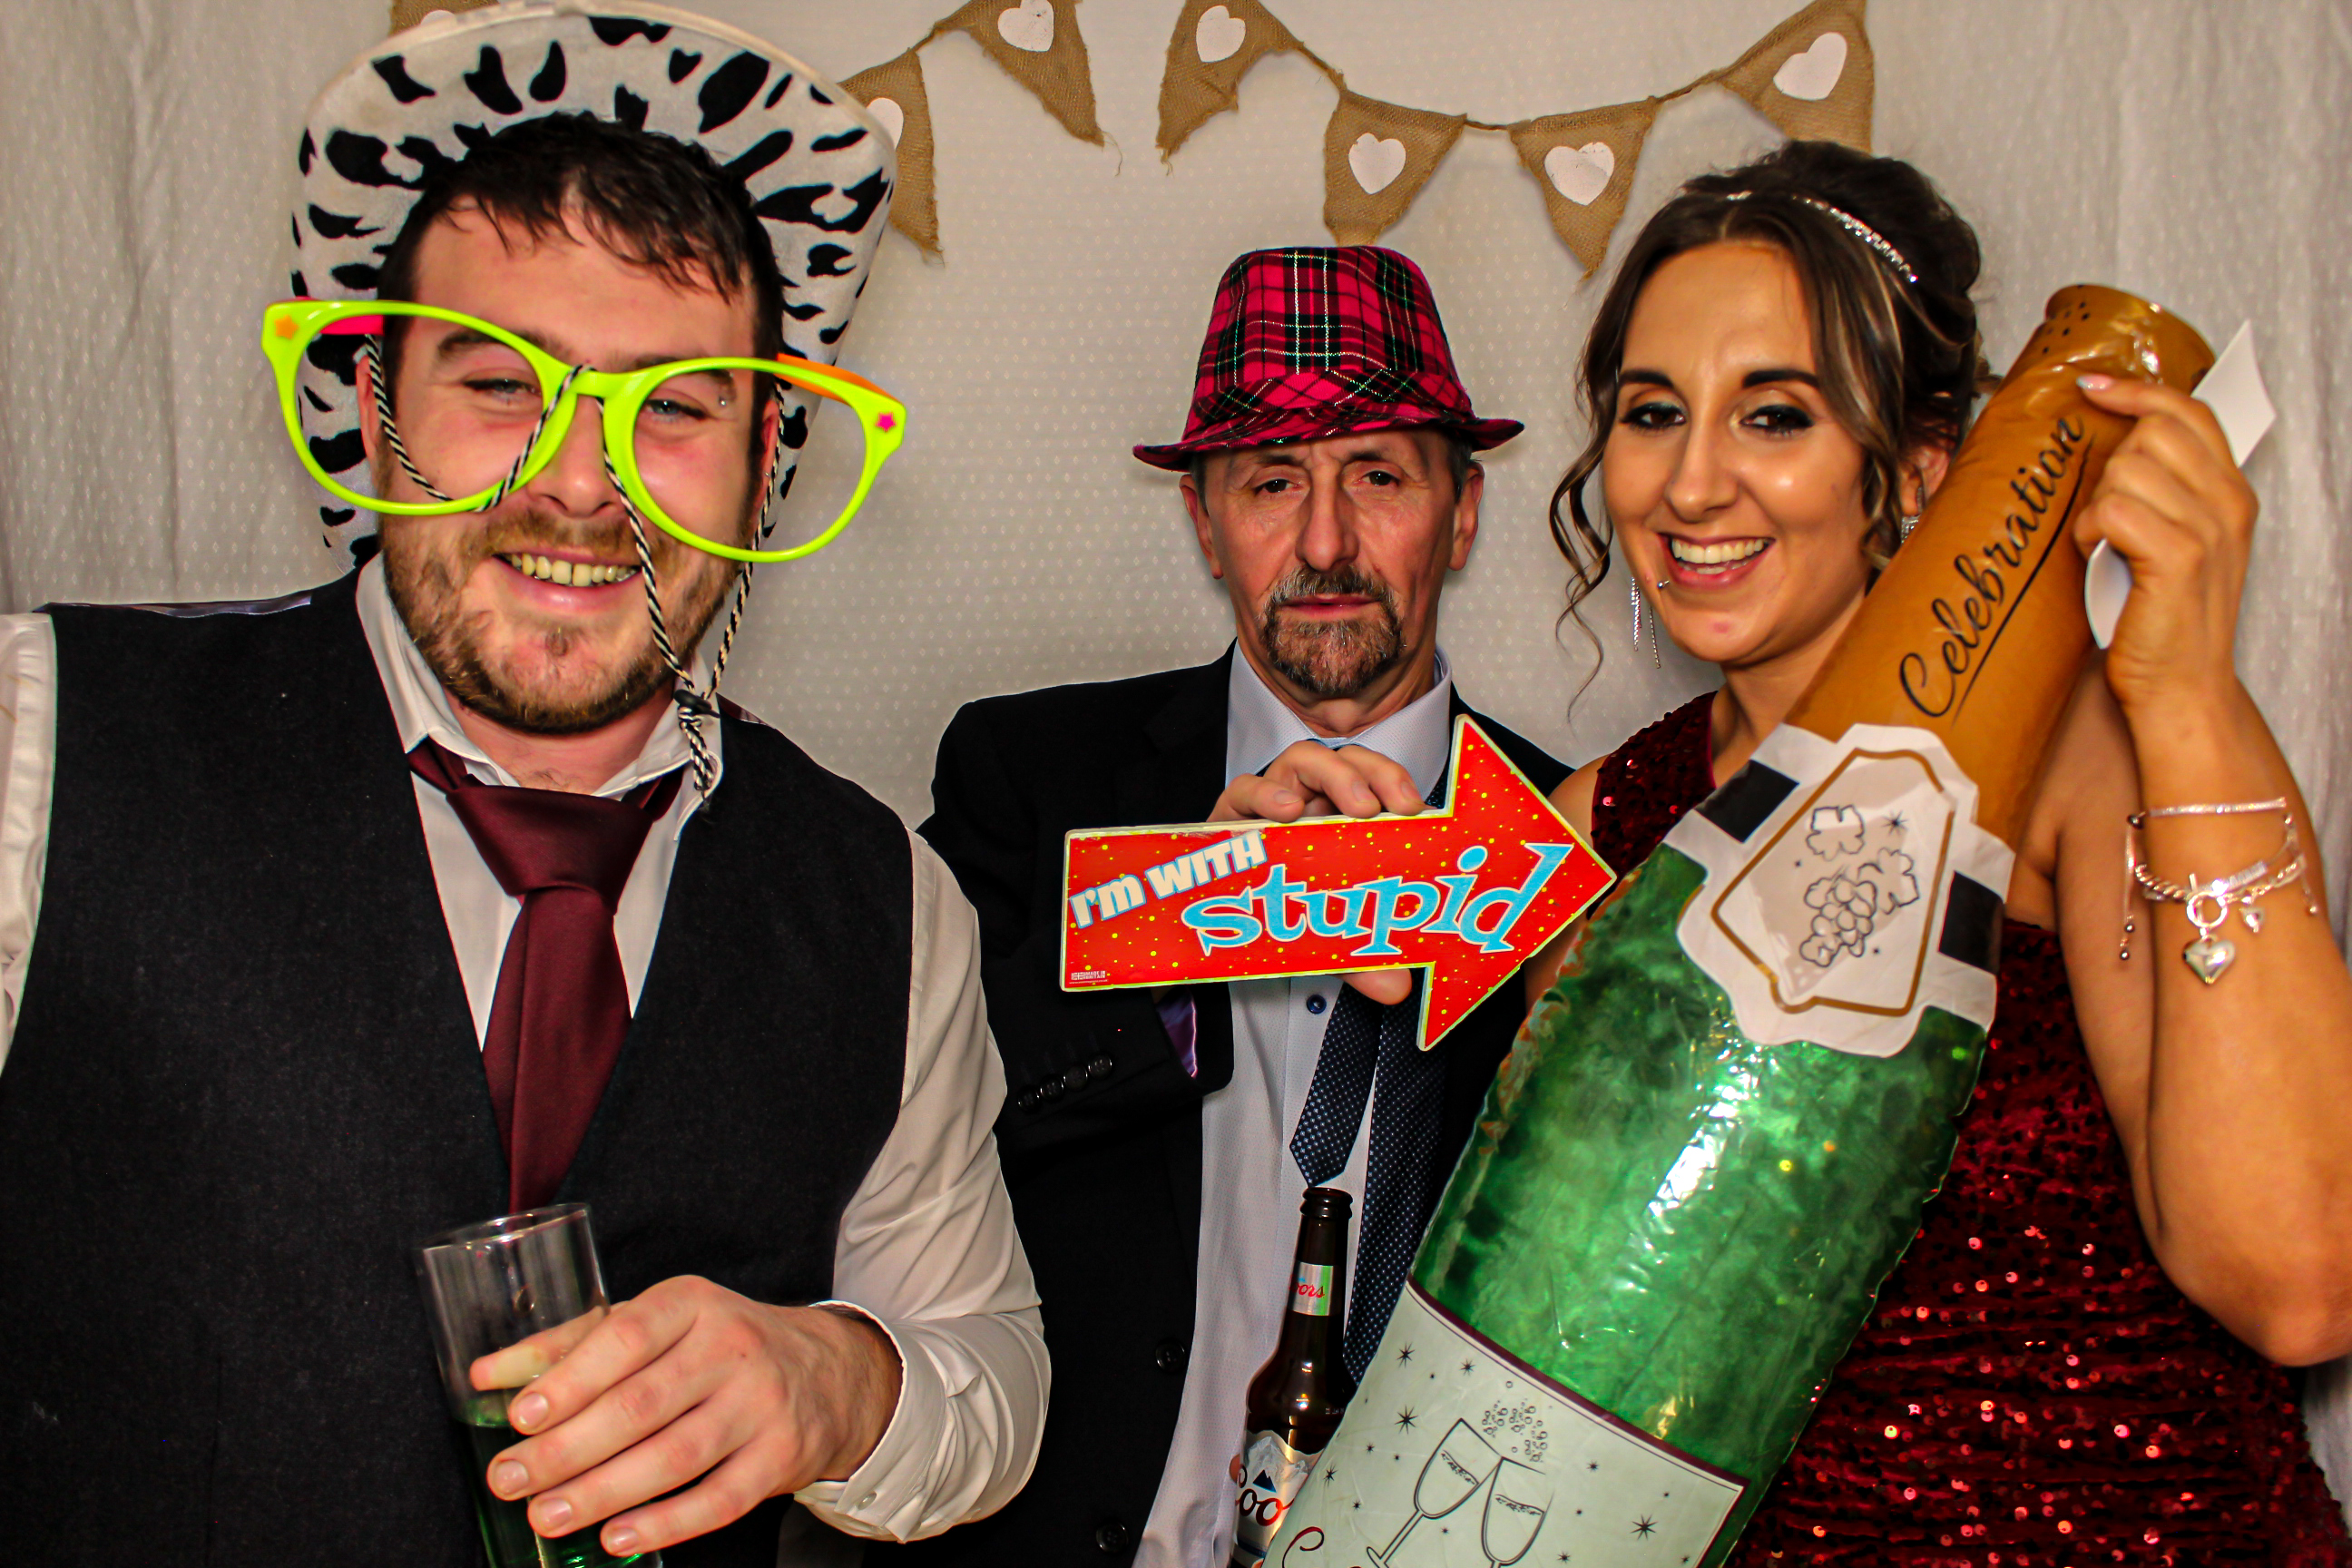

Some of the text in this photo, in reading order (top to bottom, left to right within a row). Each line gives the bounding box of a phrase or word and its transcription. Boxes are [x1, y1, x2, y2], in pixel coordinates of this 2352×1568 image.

[1898, 415, 2084, 718] Celebration
[1069, 829, 1268, 929] I'm WITH
[1181, 842, 1575, 957] stupid
